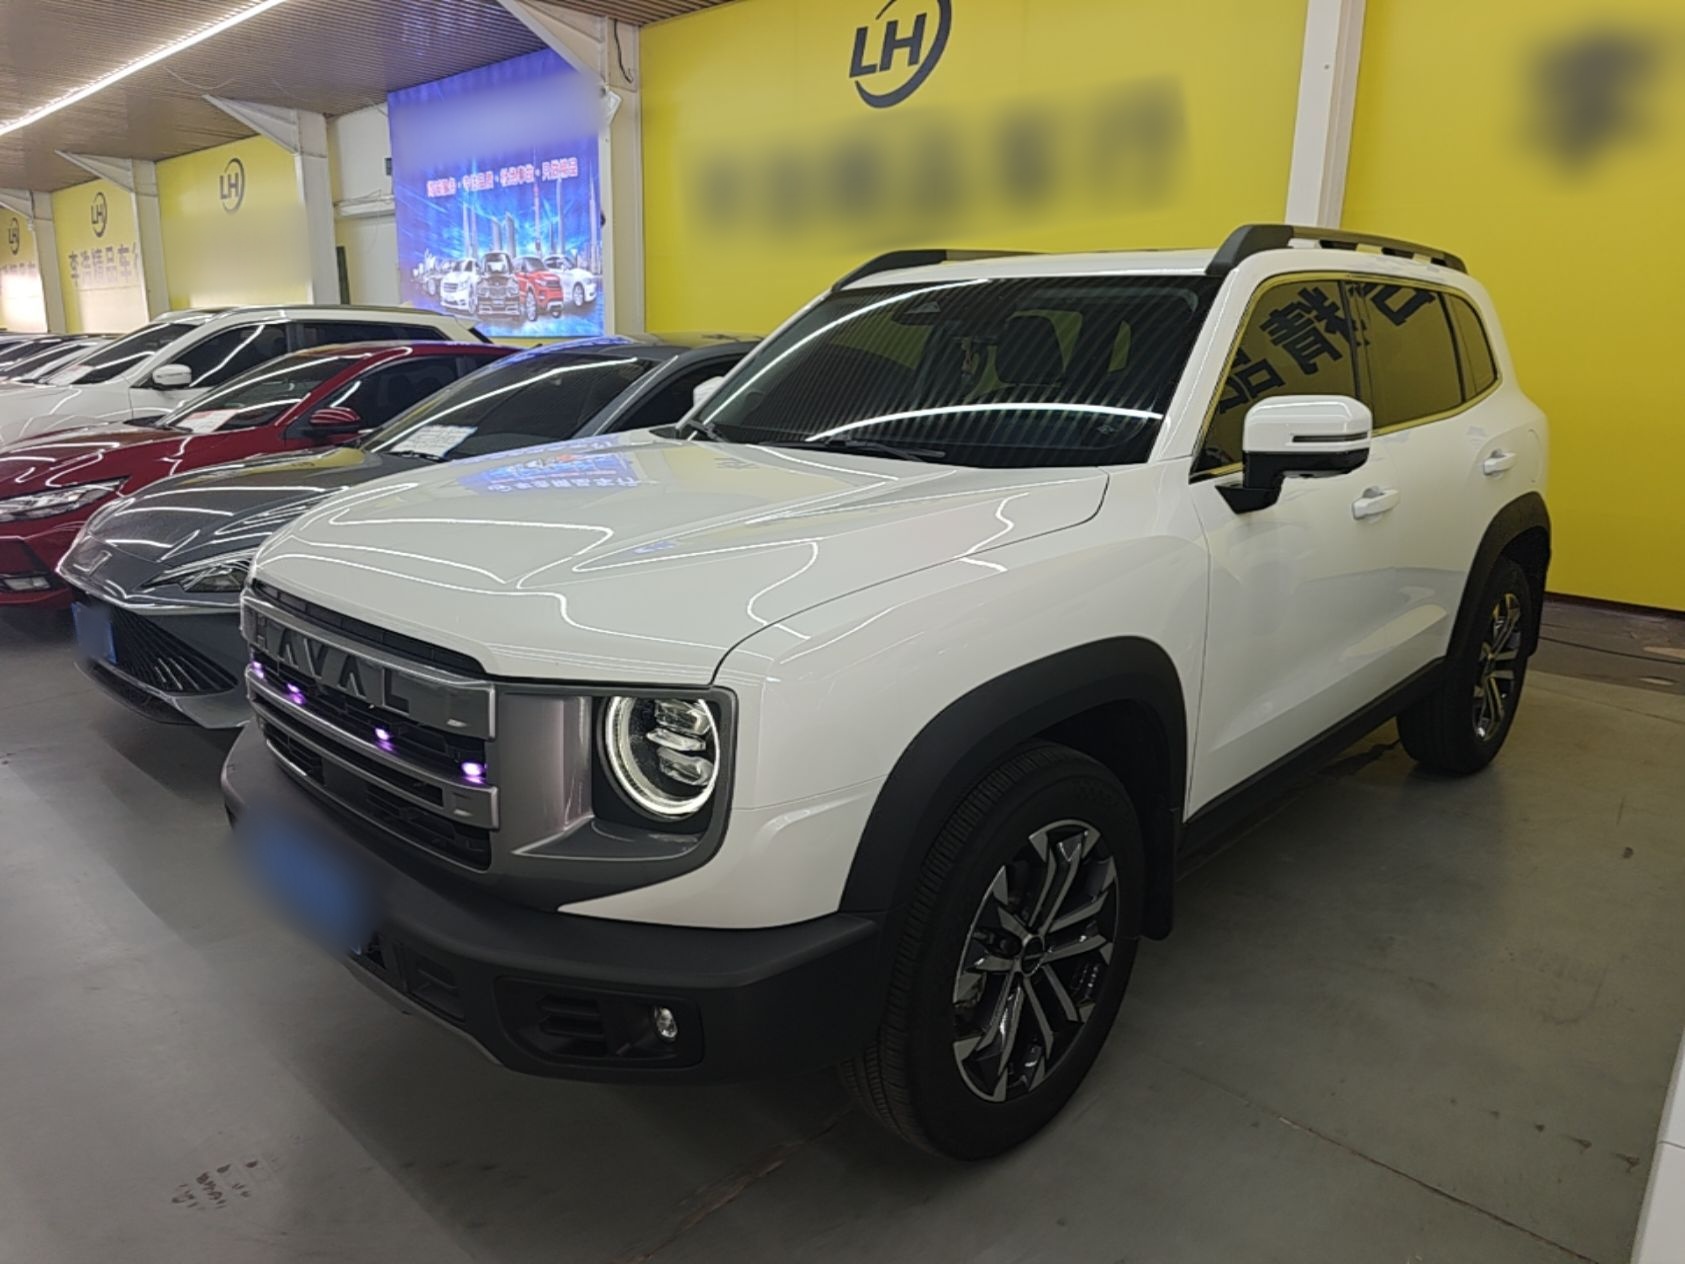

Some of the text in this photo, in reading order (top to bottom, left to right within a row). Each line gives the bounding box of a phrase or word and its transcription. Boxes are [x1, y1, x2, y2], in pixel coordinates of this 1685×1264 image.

[849, 12, 928, 79] LH
[219, 172, 240, 200] LH
[90, 203, 104, 225] LH
[256, 612, 411, 716] HAVAL
